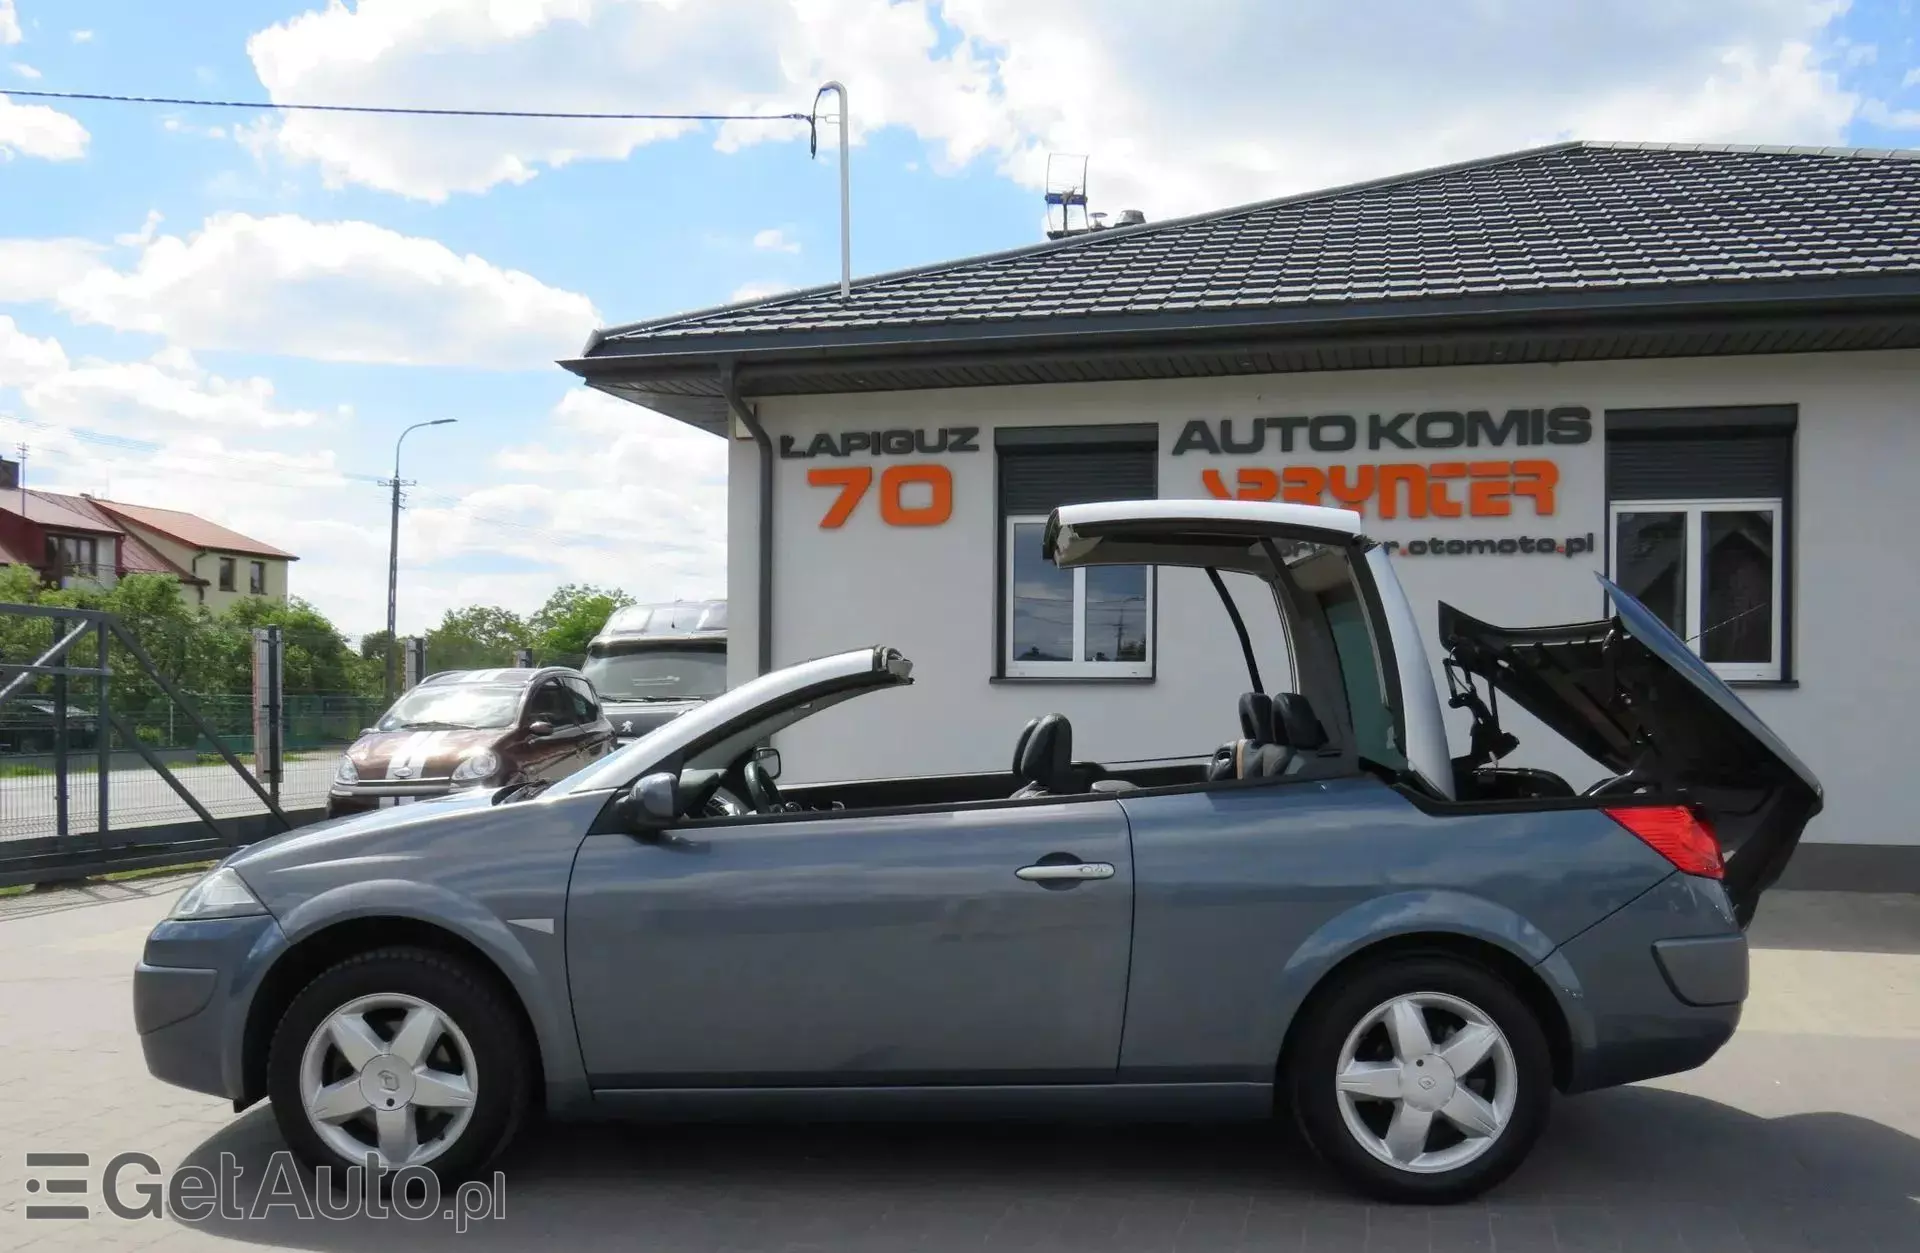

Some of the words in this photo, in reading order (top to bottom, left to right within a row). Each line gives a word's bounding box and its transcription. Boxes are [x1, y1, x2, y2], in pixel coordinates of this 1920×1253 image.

[1172, 415, 1357, 456] AUTO
[1368, 406, 1592, 450] KOMIS
[807, 464, 953, 529] 70
